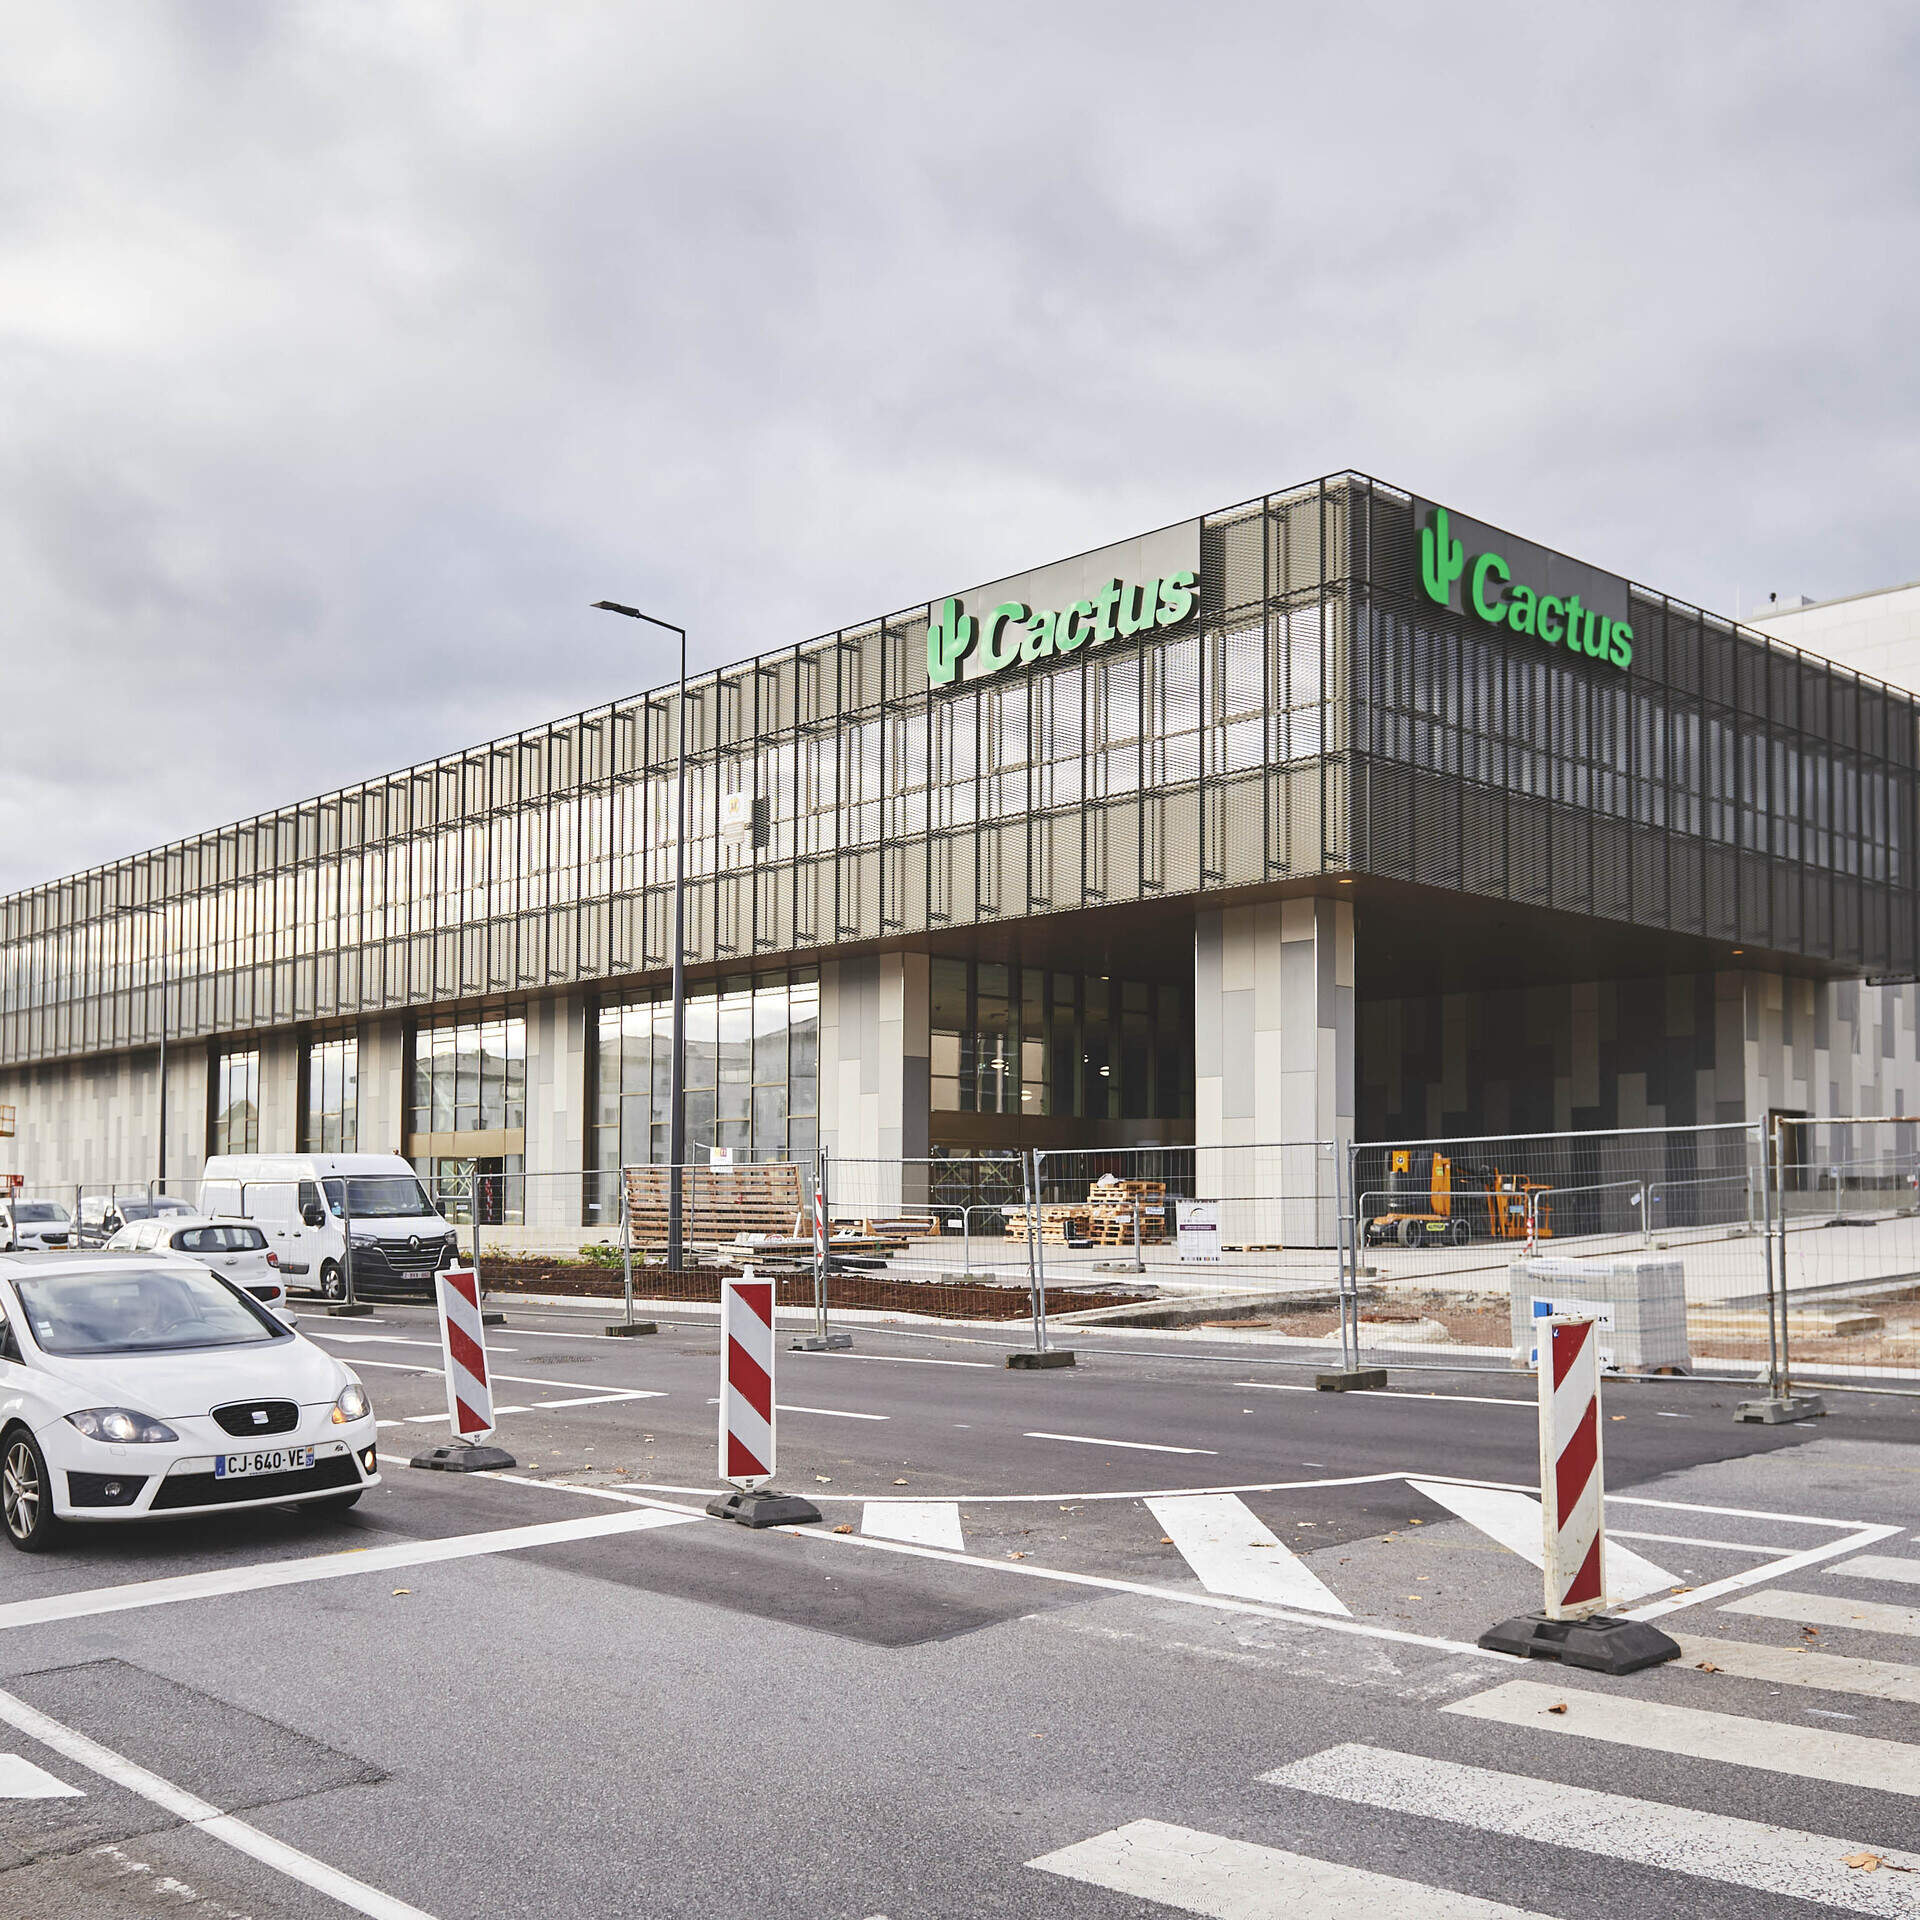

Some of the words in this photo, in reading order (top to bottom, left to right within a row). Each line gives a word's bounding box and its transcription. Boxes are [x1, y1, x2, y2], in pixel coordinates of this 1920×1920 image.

[981, 570, 1197, 671] Cactus
[1472, 552, 1634, 667] Cactus
[228, 1448, 305, 1473] CJ-640-VE
